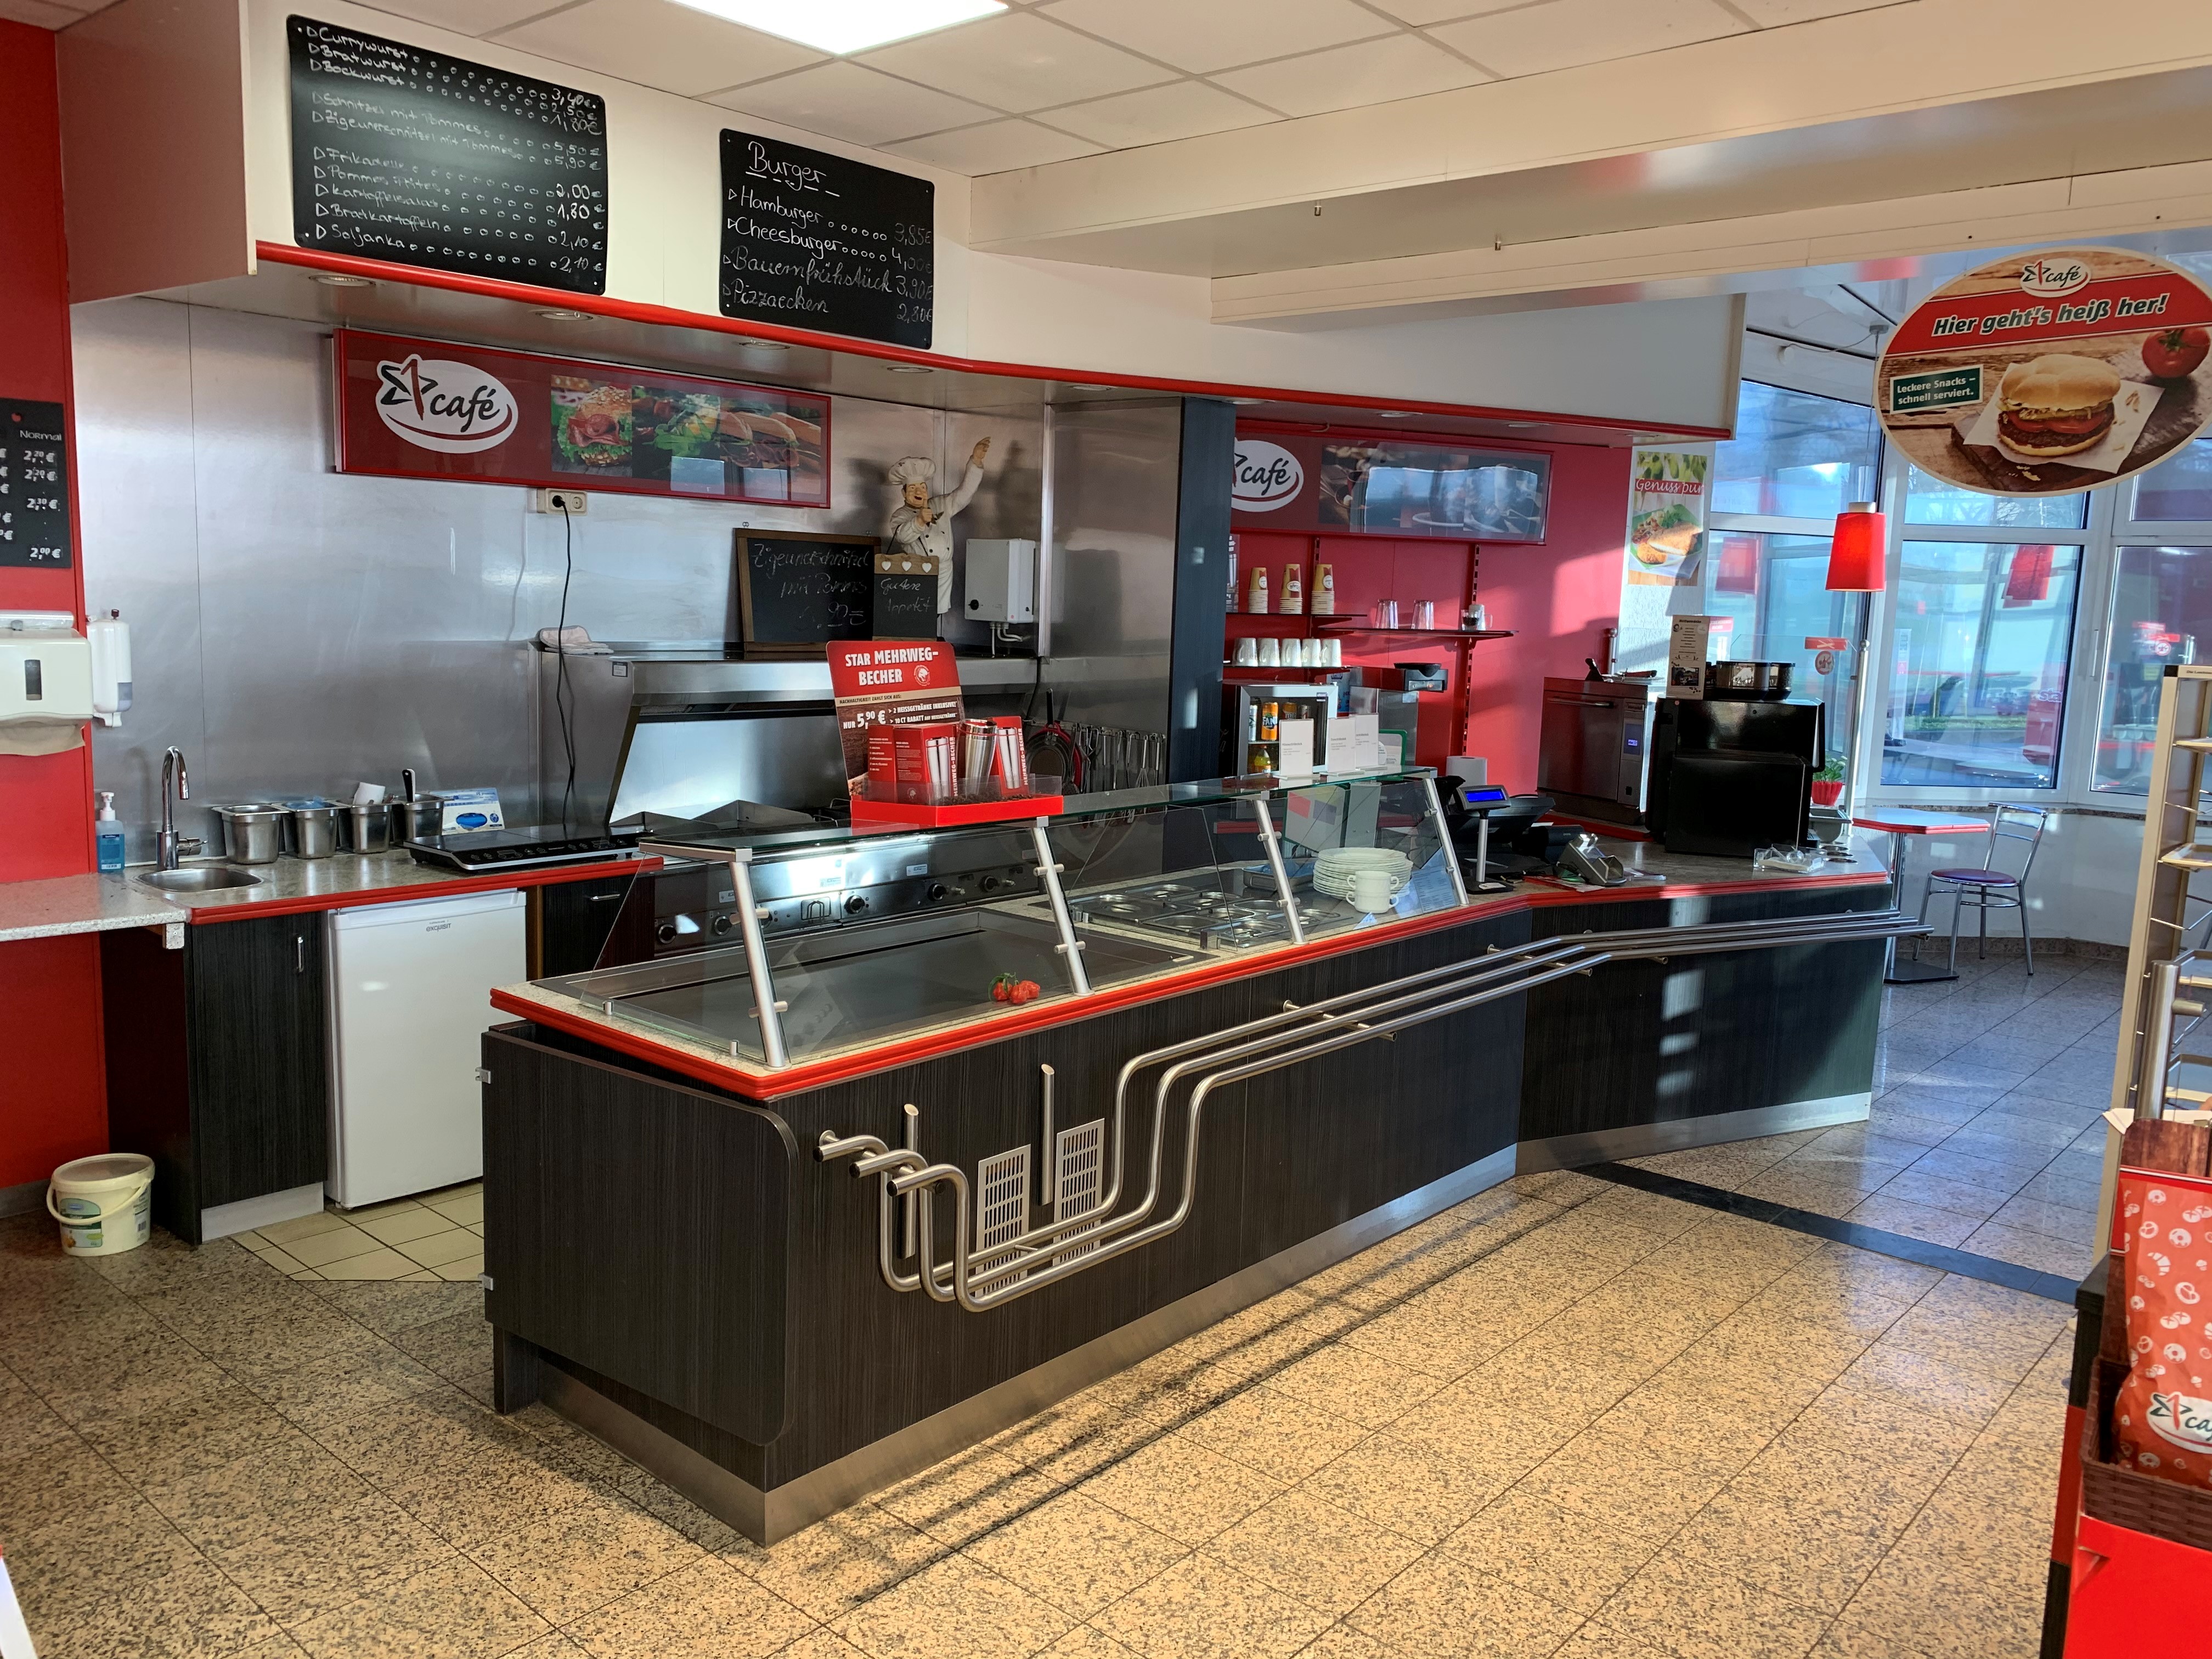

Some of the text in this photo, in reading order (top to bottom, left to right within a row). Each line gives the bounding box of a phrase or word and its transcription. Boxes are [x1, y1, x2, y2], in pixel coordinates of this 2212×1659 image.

[320, 27, 408, 59] Currywurst
[321, 44, 405, 72] Bratwurst
[323, 60, 404, 86] Bockwurst
[324, 93, 383, 114] Schnitzel
[391, 109, 417, 120] mit
[440, 135, 459, 146] mit
[328, 165, 388, 185] Pommes
[748, 141, 827, 191] Burger
[330, 204, 439, 232] Bratkartoffeln
[741, 185, 824, 229] Hamburger
[331, 224, 405, 247] Soljanka
[735, 217, 843, 259] Cheesburger
[731, 245, 893, 293] Bauernfrühstück
[2045, 266, 2081, 287] café
[732, 278, 829, 313] Pizzaecken
[1932, 293, 2170, 336] Hier geht's heiß her!
[1897, 382, 1931, 393] Leckere
[1934, 377, 1966, 388] Snacks
[1898, 387, 1974, 405] schnell serviert.
[430, 385, 500, 433] café
[1241, 458, 1291, 496] café
[1636, 478, 1680, 493] Genuss
[881, 578, 921, 595] Guten
[845, 646, 939, 667] STAR MEHRWEG-
[858, 668, 903, 686] BECHER
[843, 721, 856, 729] NUR
[950, 737, 958, 797] MEHRWEG-BECHER
[1018, 728, 1028, 786] MEHRWEG-BECHER
